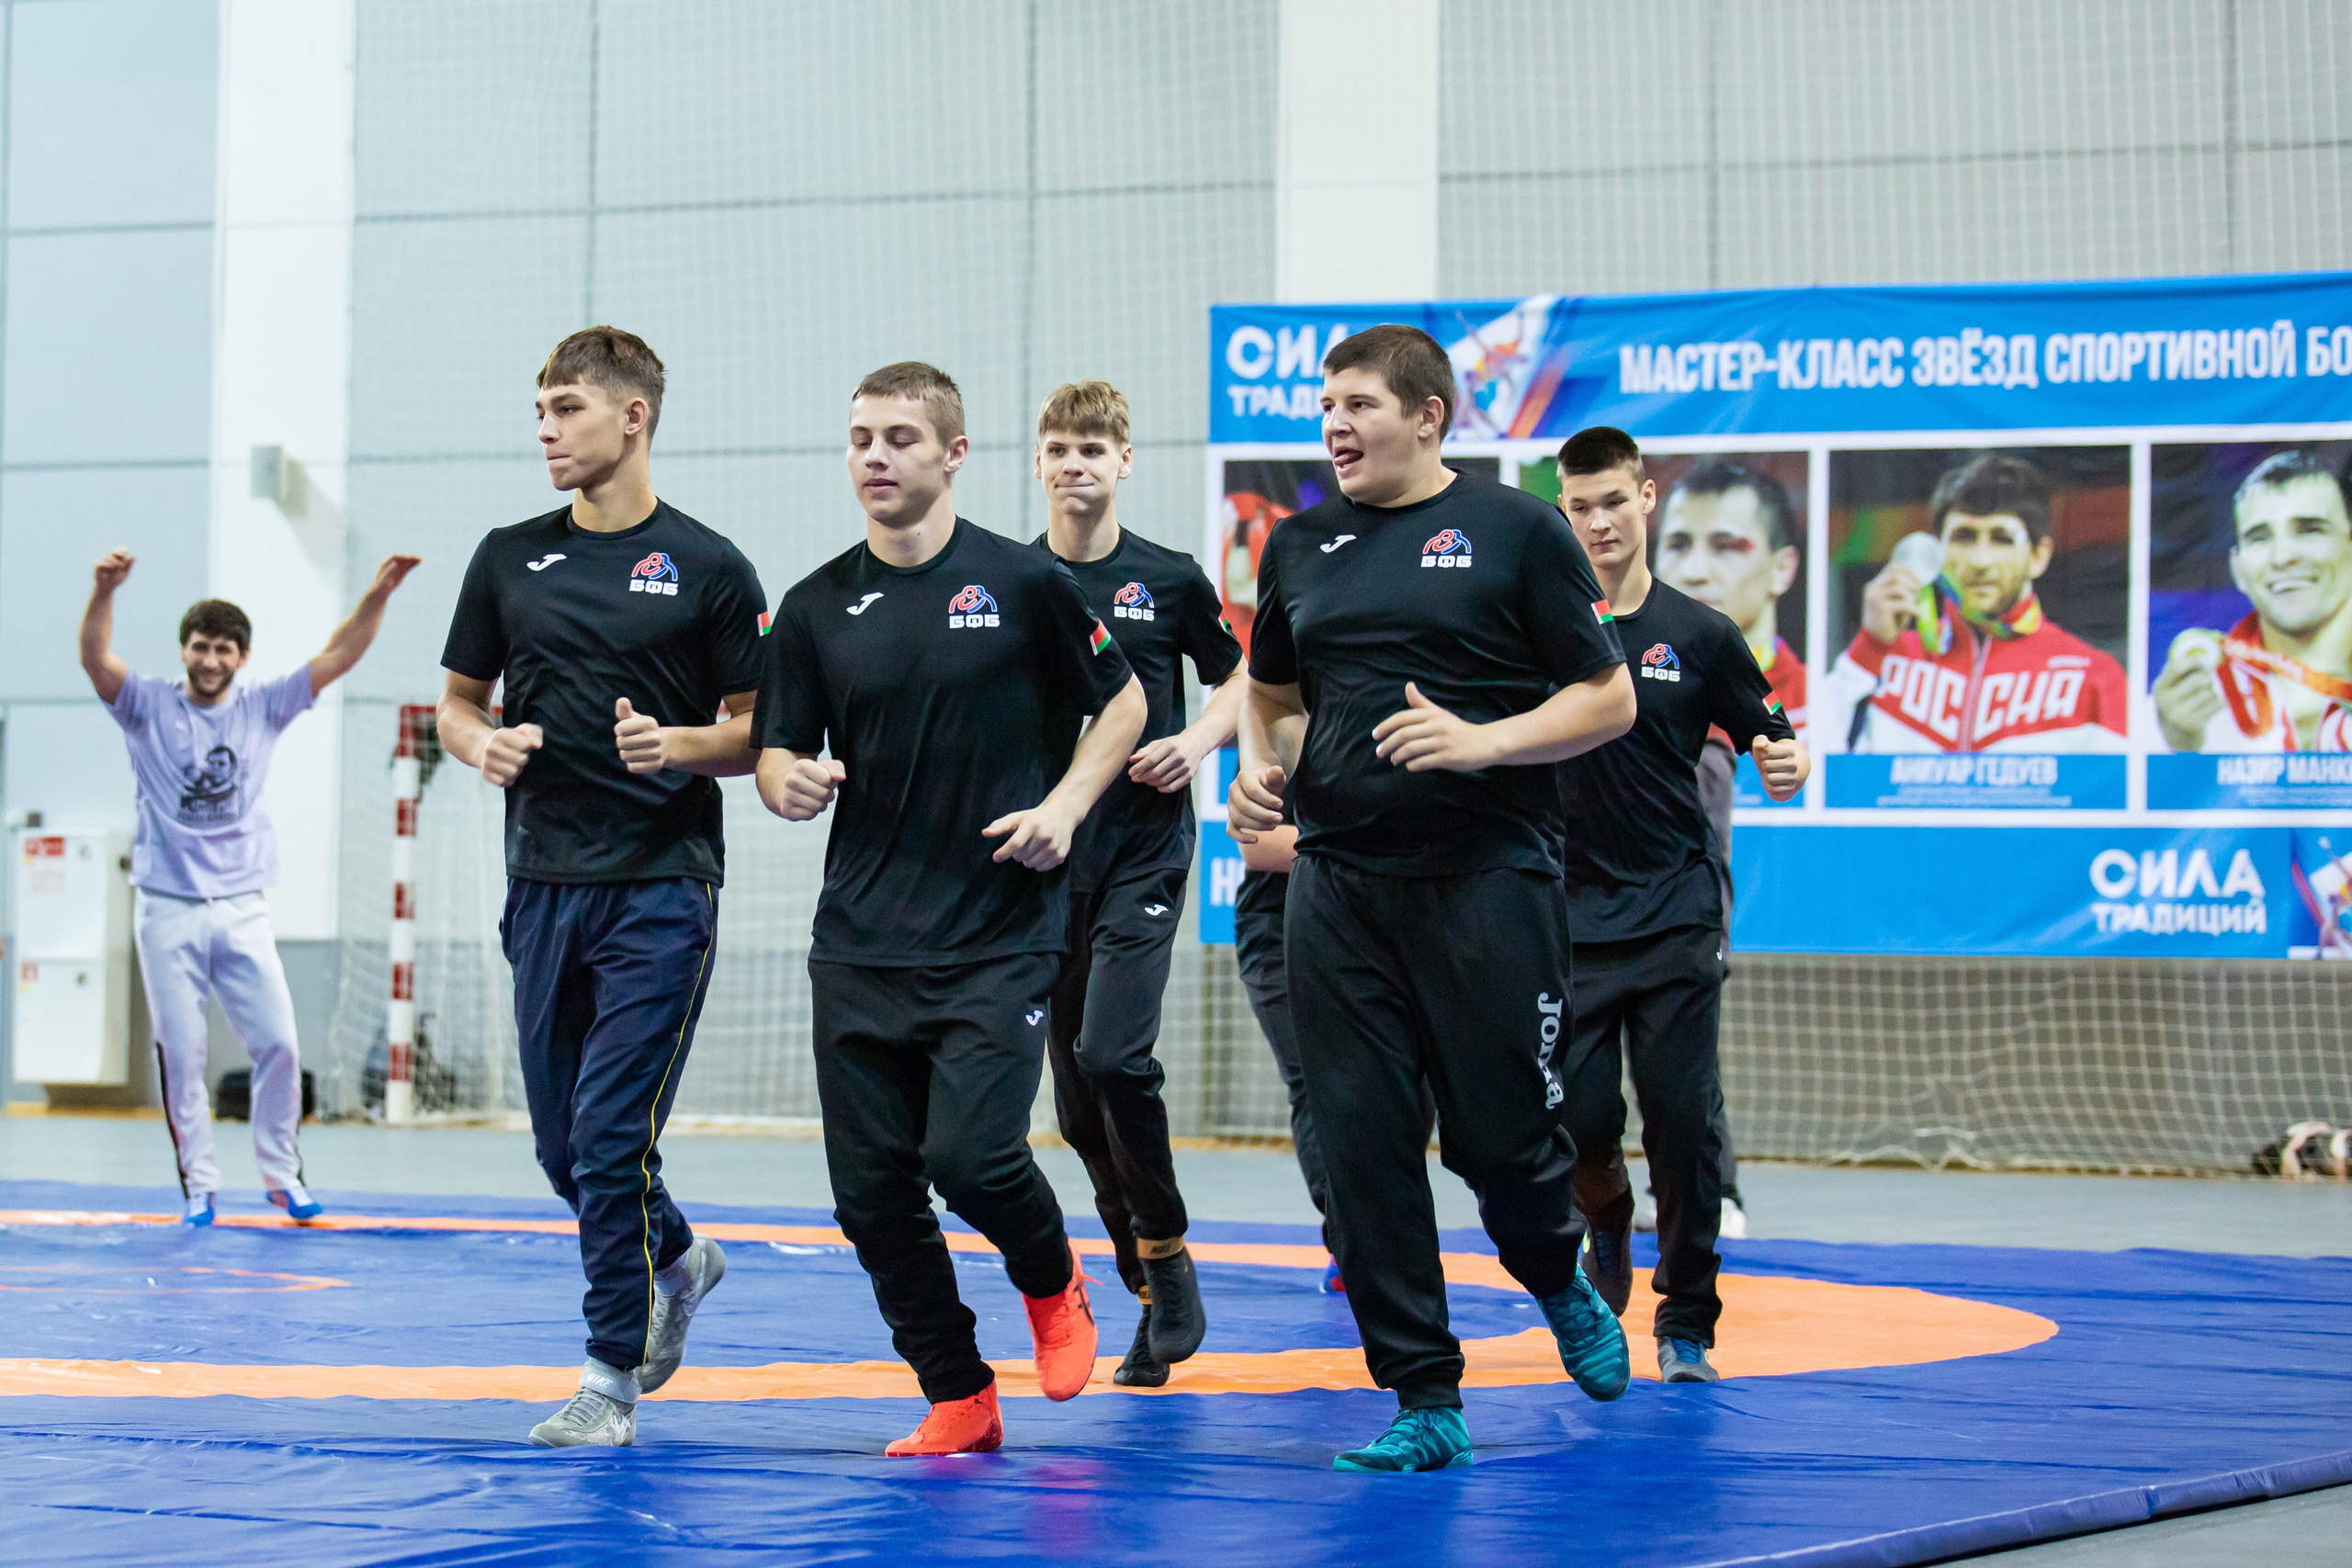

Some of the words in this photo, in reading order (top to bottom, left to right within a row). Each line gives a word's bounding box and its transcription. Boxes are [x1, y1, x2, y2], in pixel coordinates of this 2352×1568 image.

[1620, 336, 1905, 394] МАСТЕР-КЛАСС
[1911, 327, 2040, 389] ЗВЁЗД
[2044, 319, 2297, 384] СПОРТИВНОЙ
[2089, 848, 2267, 898] СИЛА
[2090, 897, 2267, 936] ТРАДИЦИЙ
[587, 1372, 614, 1388] NIKE
